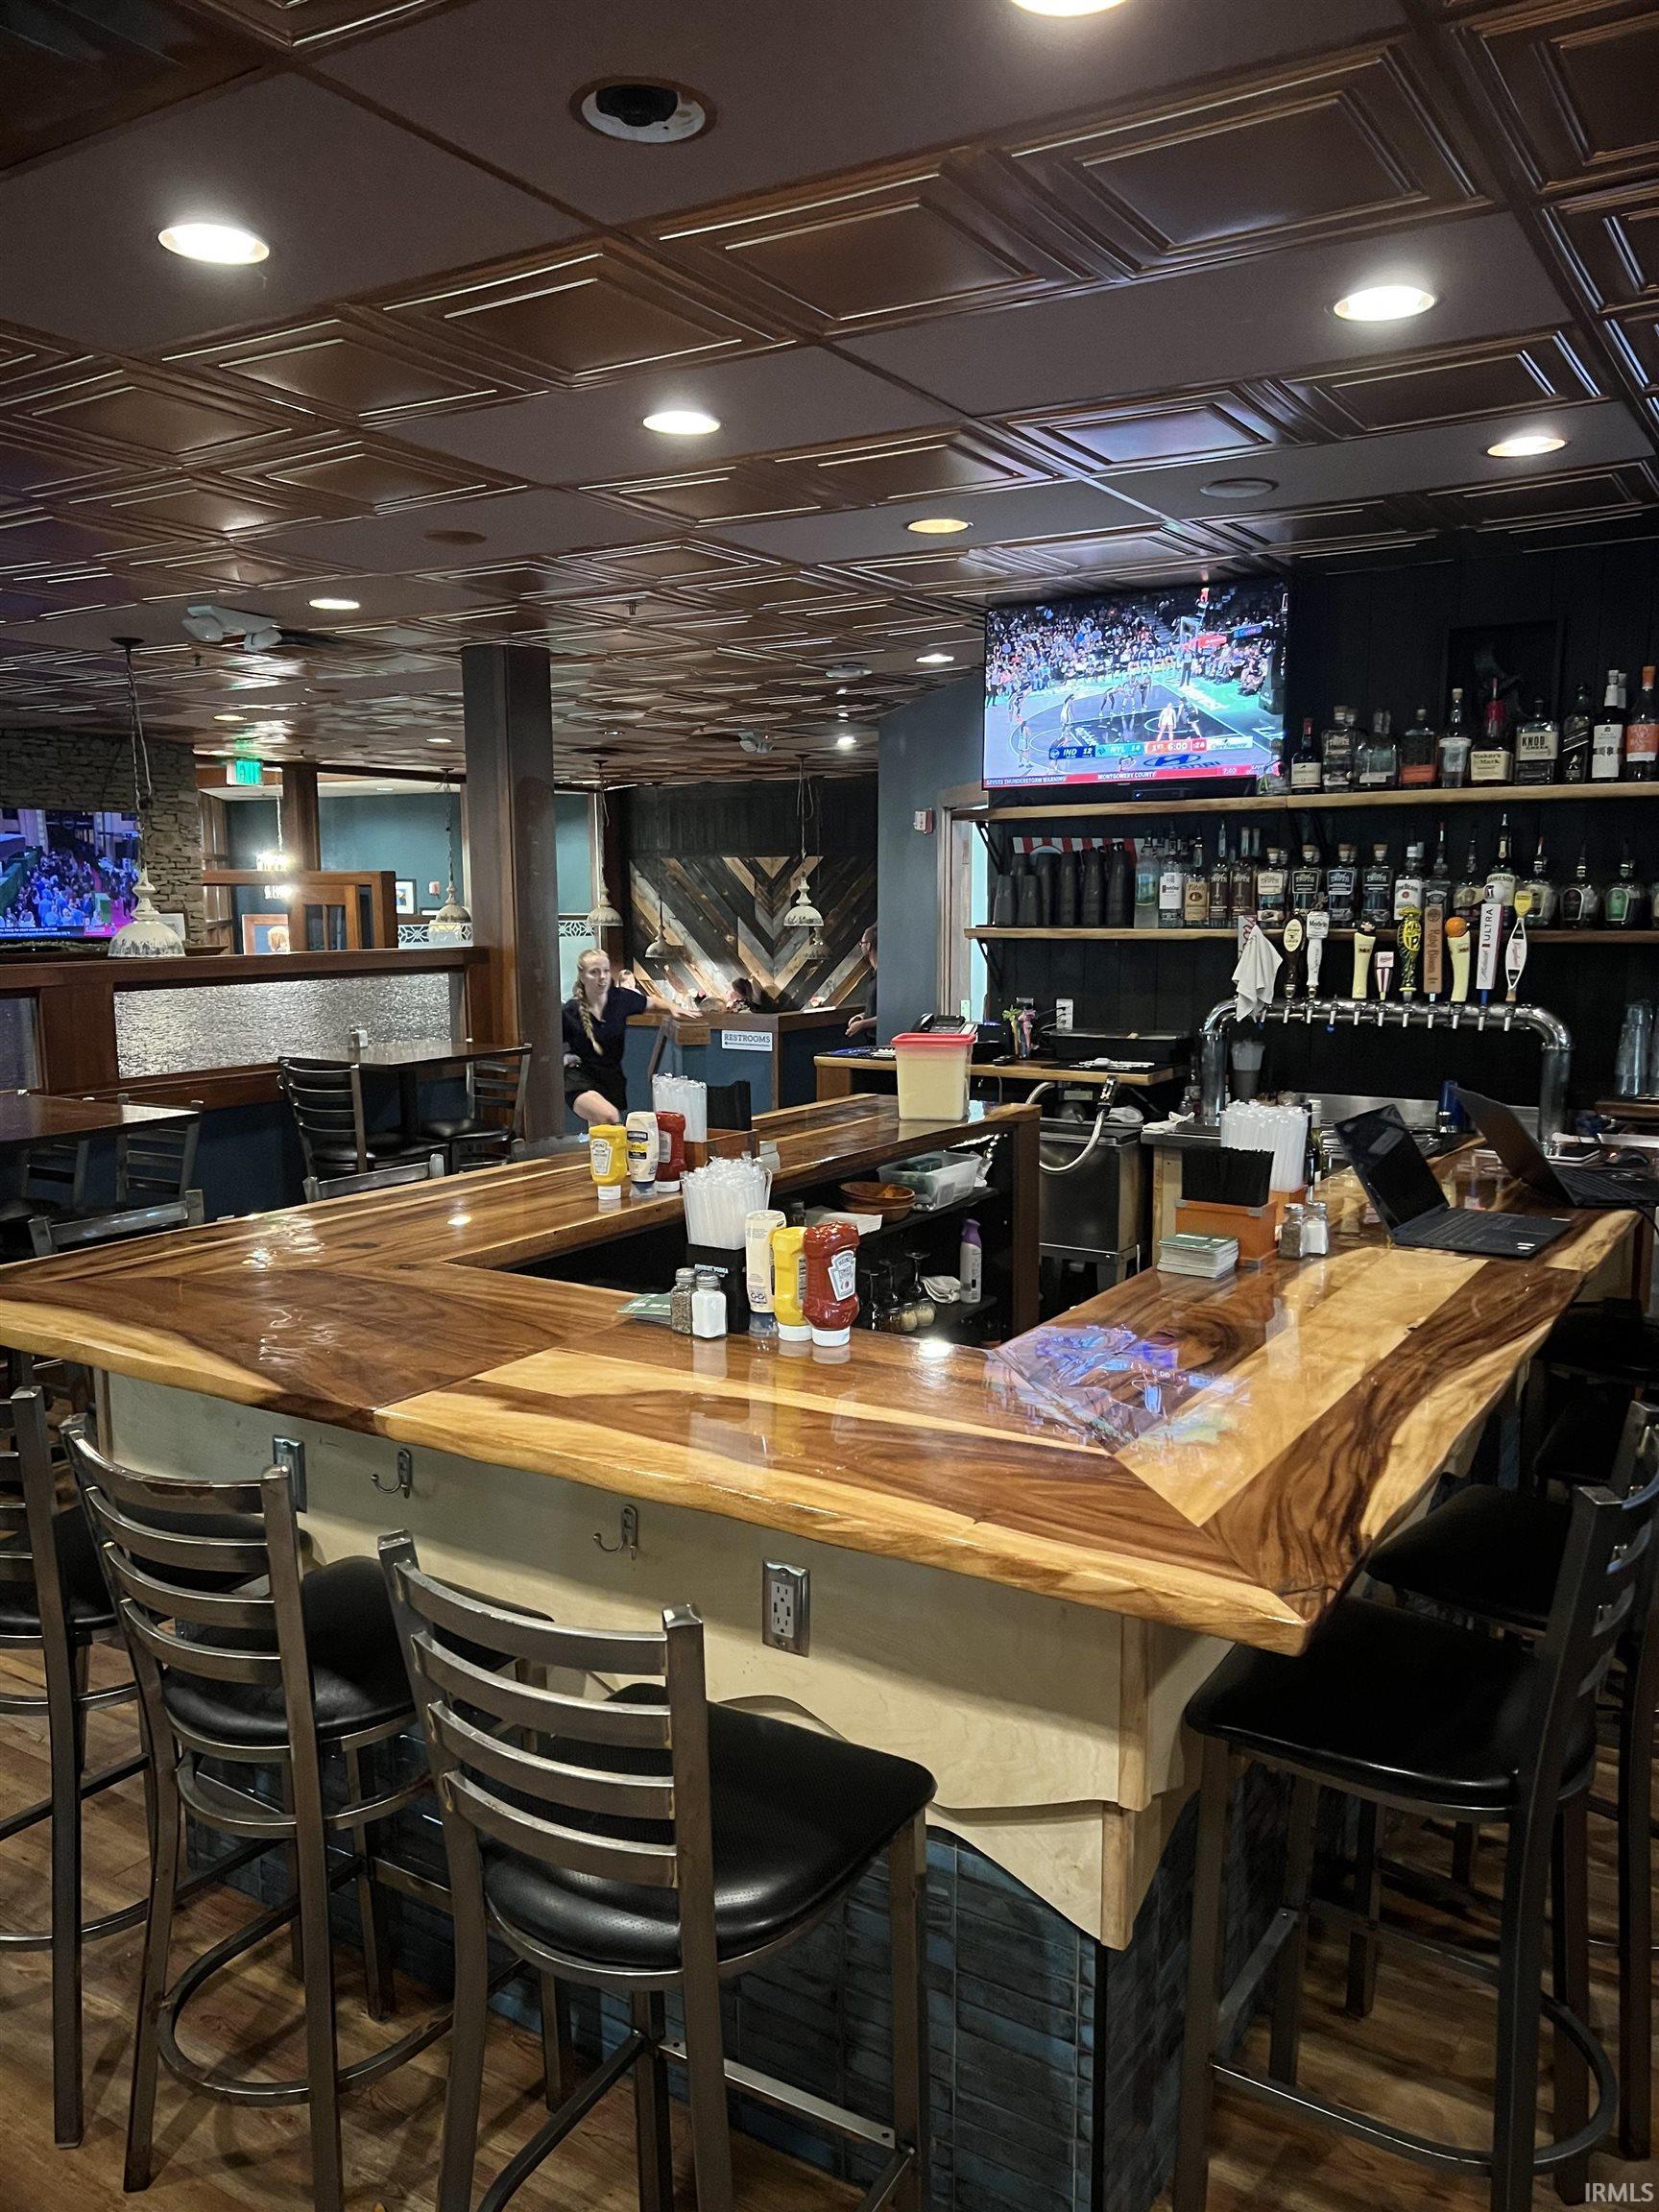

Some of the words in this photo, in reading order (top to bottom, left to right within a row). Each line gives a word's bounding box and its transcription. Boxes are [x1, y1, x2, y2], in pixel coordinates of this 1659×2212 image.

[1522, 735, 1546, 746] KNOB
[1167, 742, 1188, 751] 6:00
[1063, 748, 1077, 757] IND
[1082, 747, 1093, 756] 12
[1097, 772, 1134, 781] MONTGOMERY
[1483, 908, 1494, 942] ULTRA
[724, 1033, 771, 1044] RESTROOMS
